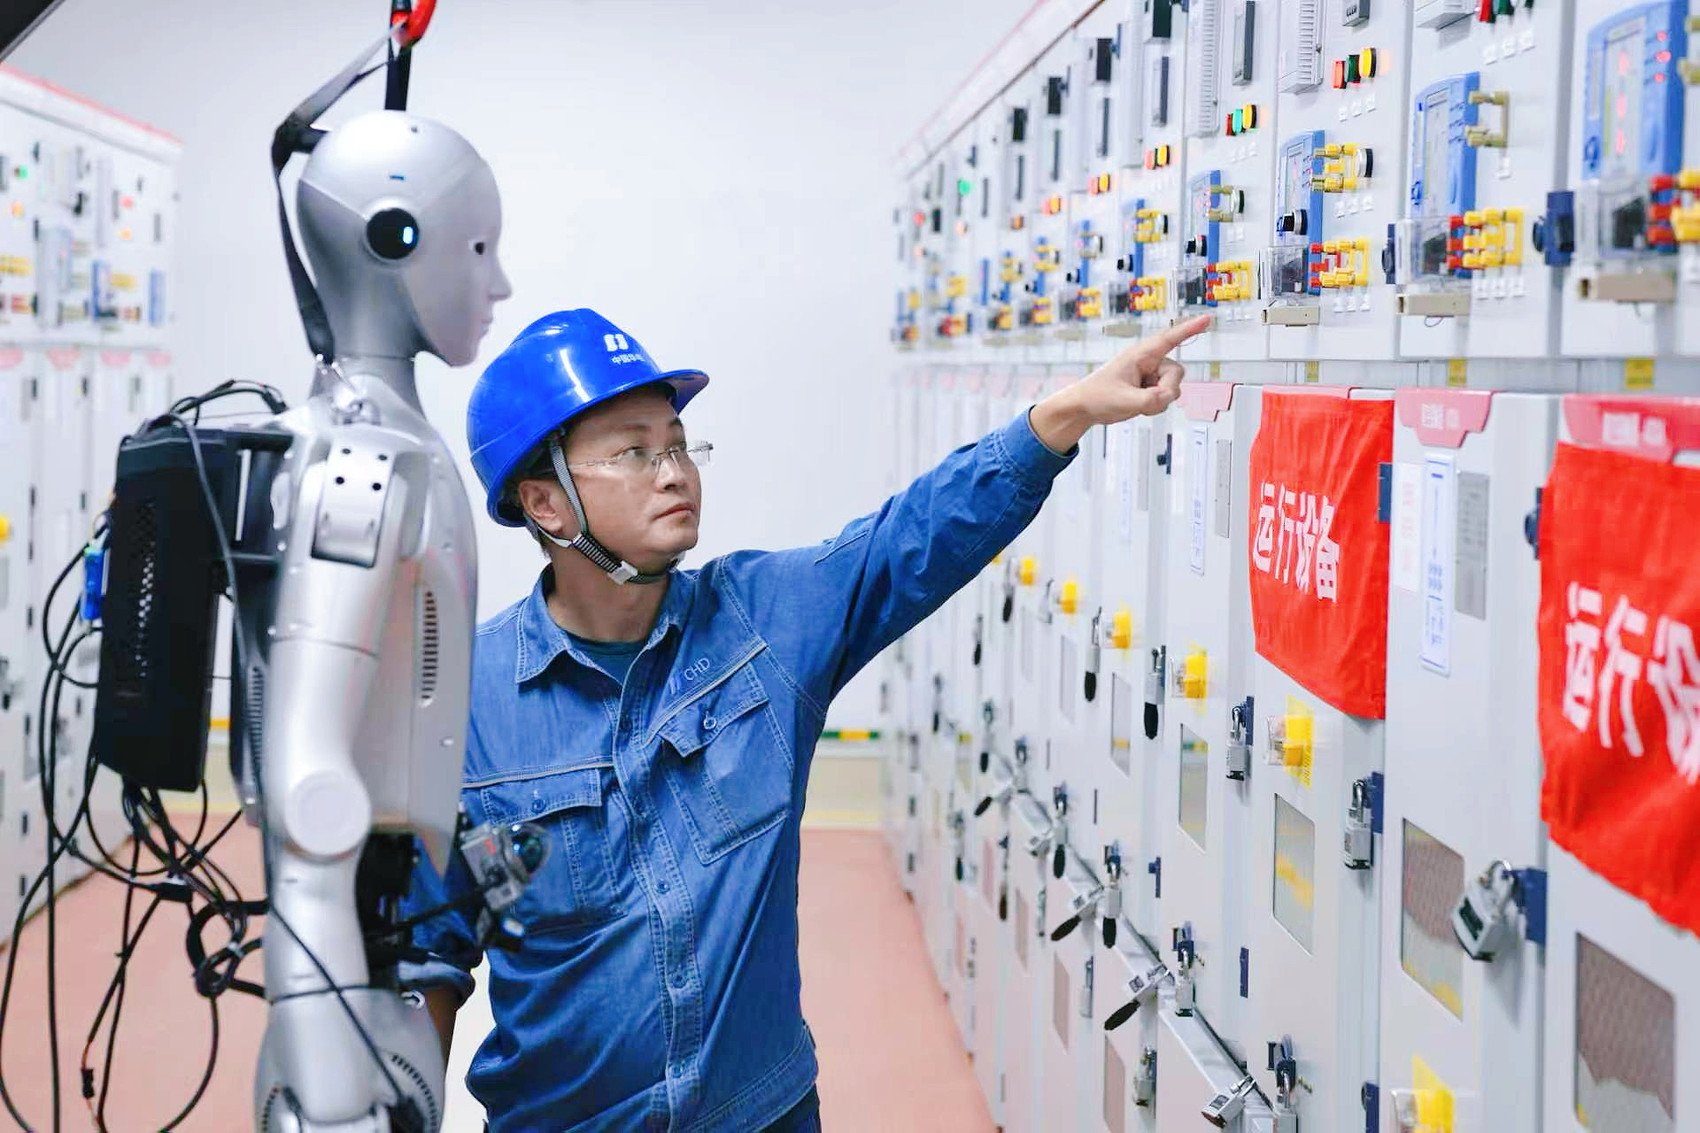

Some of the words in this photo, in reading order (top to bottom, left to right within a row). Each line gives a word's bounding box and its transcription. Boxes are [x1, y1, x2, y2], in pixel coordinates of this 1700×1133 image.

[1253, 480, 1340, 603] 运行设备
[684, 657, 710, 681] CHD
